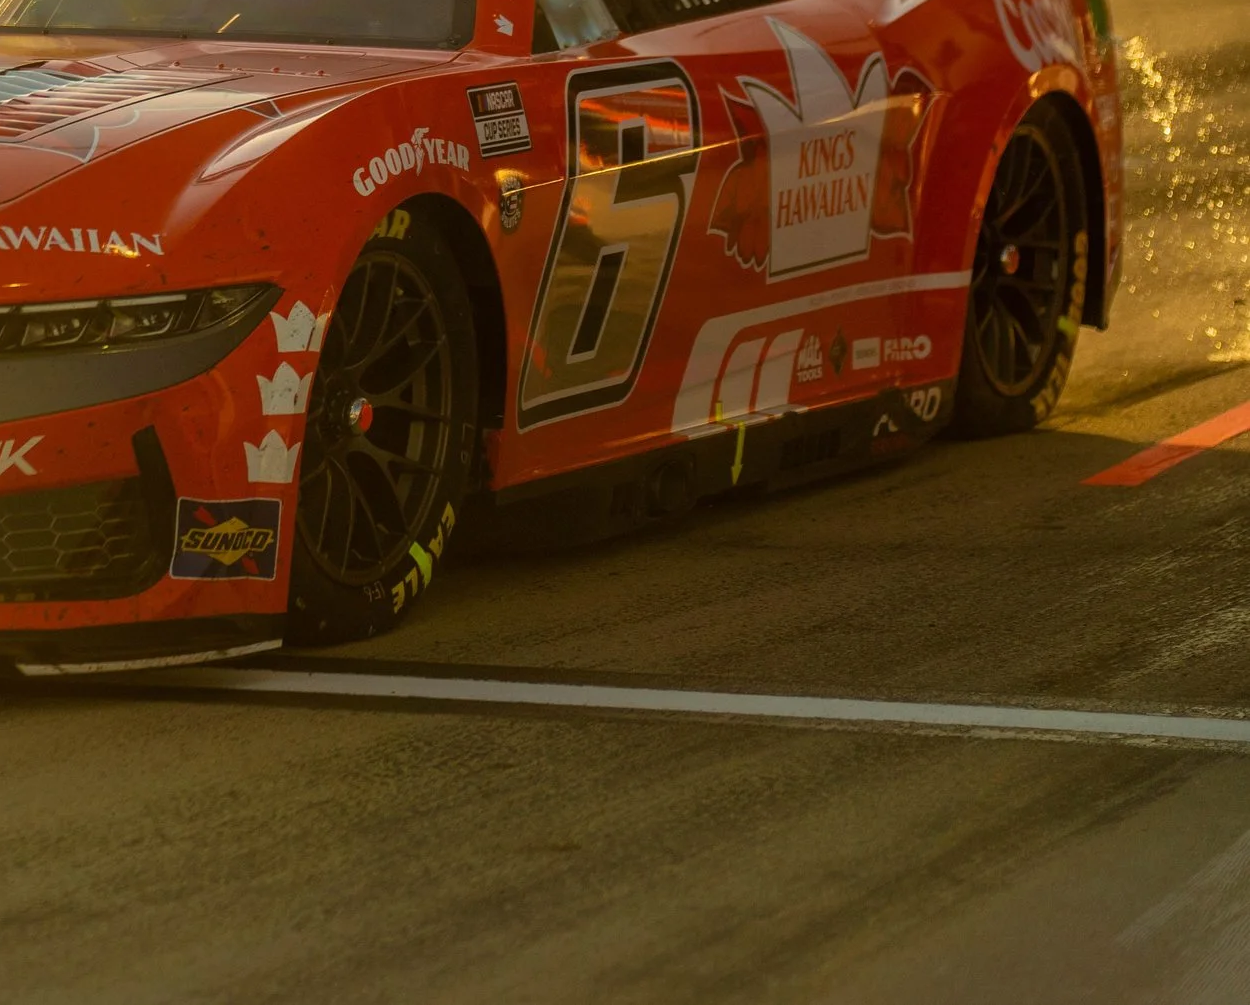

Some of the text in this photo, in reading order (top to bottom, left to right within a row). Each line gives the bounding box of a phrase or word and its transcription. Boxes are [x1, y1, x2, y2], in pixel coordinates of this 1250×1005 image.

[485, 89, 515, 111] NASCAR
[483, 117, 521, 141] CUP SERIES
[798, 129, 856, 180] KING'S
[353, 133, 470, 196] GOODYEAR
[776, 172, 870, 229] HAWAIIAN
[516, 57, 702, 434] 6
[883, 334, 932, 362] FARO
[181, 528, 274, 553] SUNOCO
[391, 501, 456, 614] EALE
